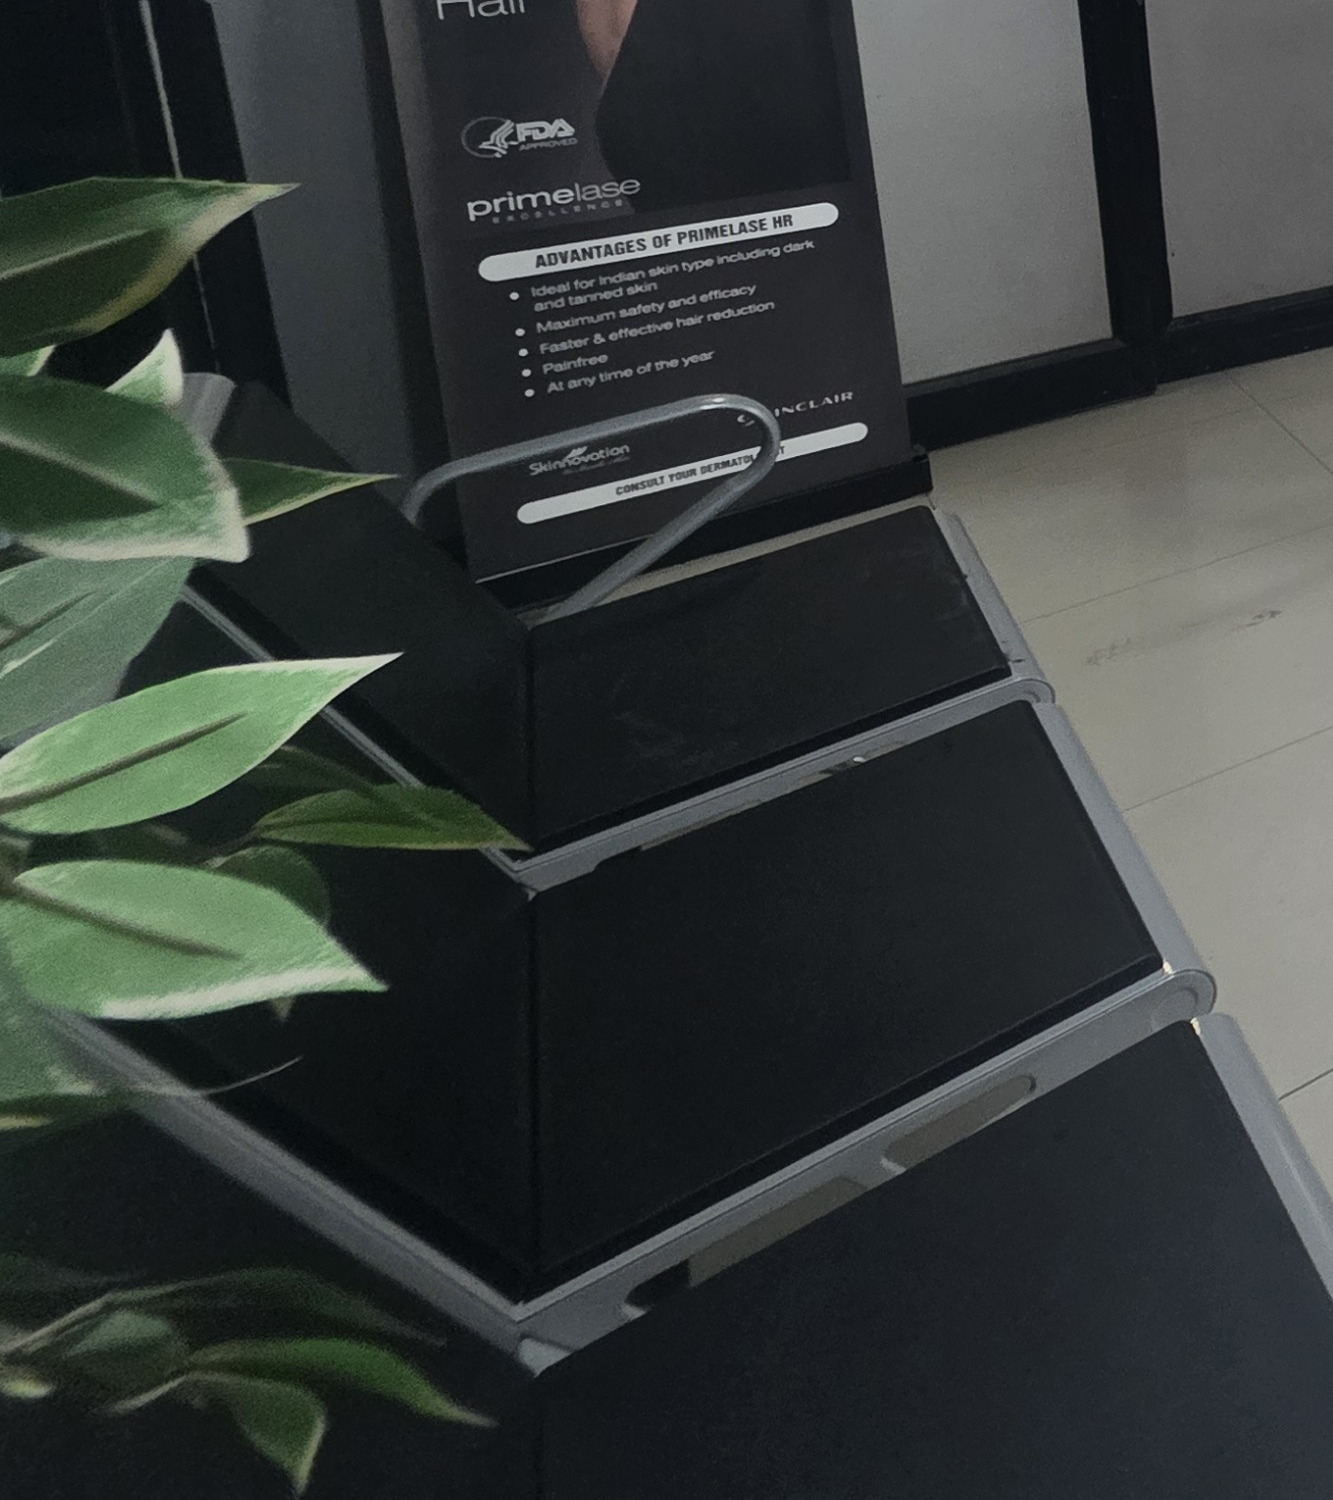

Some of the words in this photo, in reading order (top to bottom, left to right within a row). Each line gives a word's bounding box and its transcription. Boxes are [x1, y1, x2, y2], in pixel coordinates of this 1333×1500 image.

[516, 118, 576, 142] FDA
[466, 179, 641, 222] primelase
[535, 238, 647, 269] ADVANTAGES
[652, 233, 672, 249] OF
[677, 218, 769, 245] PRIMELASE
[772, 214, 794, 229] HR
[530, 281, 571, 298] Ideal
[573, 277, 597, 290] for
[599, 270, 646, 286] Indian
[648, 263, 679, 277] skin
[682, 257, 715, 273] type
[717, 246, 781, 265] including
[783, 239, 815, 254] dark
[534, 297, 566, 312] and
[568, 288, 624, 306] tanned
[626, 281, 658, 296] skin
[536, 310, 617, 334] Maximum
[618, 301, 666, 318] safety
[668, 294, 697, 309] and
[699, 284, 757, 303] efficacy
[539, 336, 590, 355] Faster
[593, 333, 606, 345] &
[608, 321, 674, 342] effective
[675, 314, 704, 328] hair
[707, 301, 776, 322] reduction
[542, 354, 609, 375] Painfree
[547, 381, 564, 394] At
[567, 376, 597, 389] any
[599, 367, 633, 383] time
[636, 362, 652, 375] of
[654, 358, 679, 372] the
[682, 350, 716, 367] year
[774, 391, 854, 418] INCLAIR
[528, 444, 630, 476] Skinnovation
[616, 475, 665, 495] CONSULT
[668, 468, 697, 483] YOUR
[700, 446, 785, 475] DERMATOT
